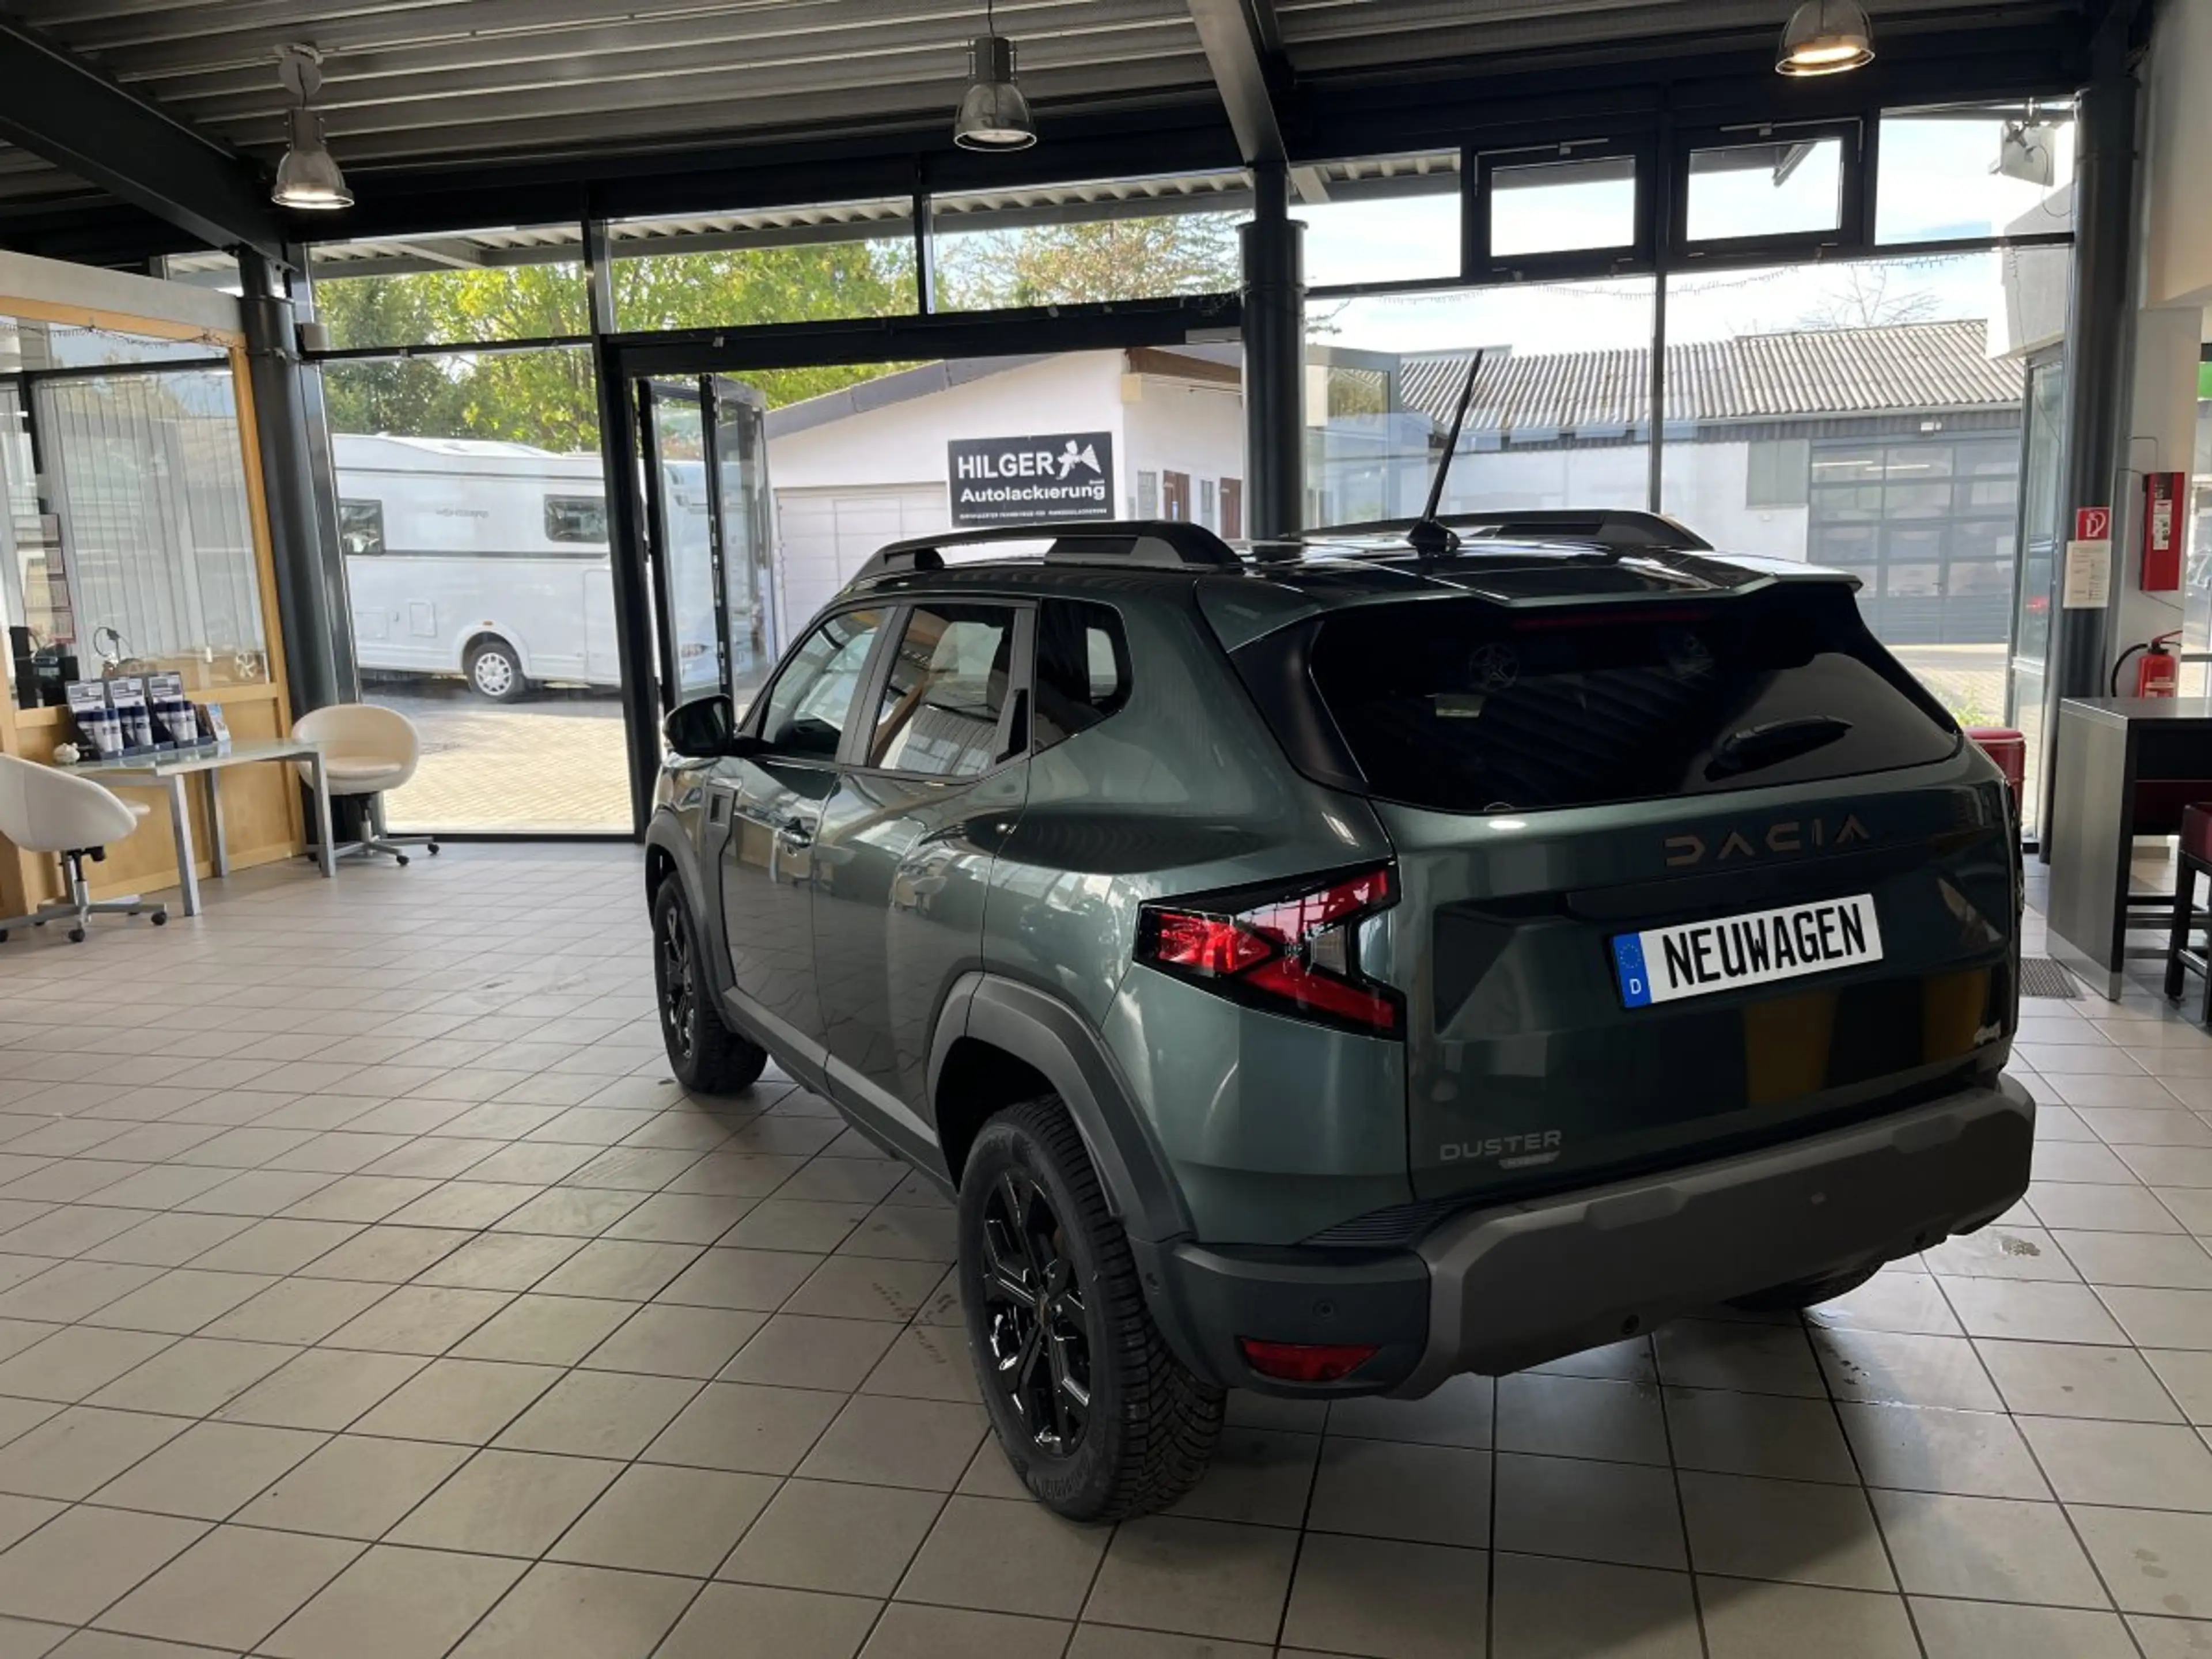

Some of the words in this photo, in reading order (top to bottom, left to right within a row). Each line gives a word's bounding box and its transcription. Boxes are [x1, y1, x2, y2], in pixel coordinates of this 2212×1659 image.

[957, 451, 1055, 479] HILGER
[960, 484, 1105, 503] Autolackierung
[1665, 813, 1870, 868] DACIA
[1662, 903, 1866, 988] NEUWAGEN
[1630, 978, 1641, 995] D
[1440, 1130, 1562, 1161] DUSTER
